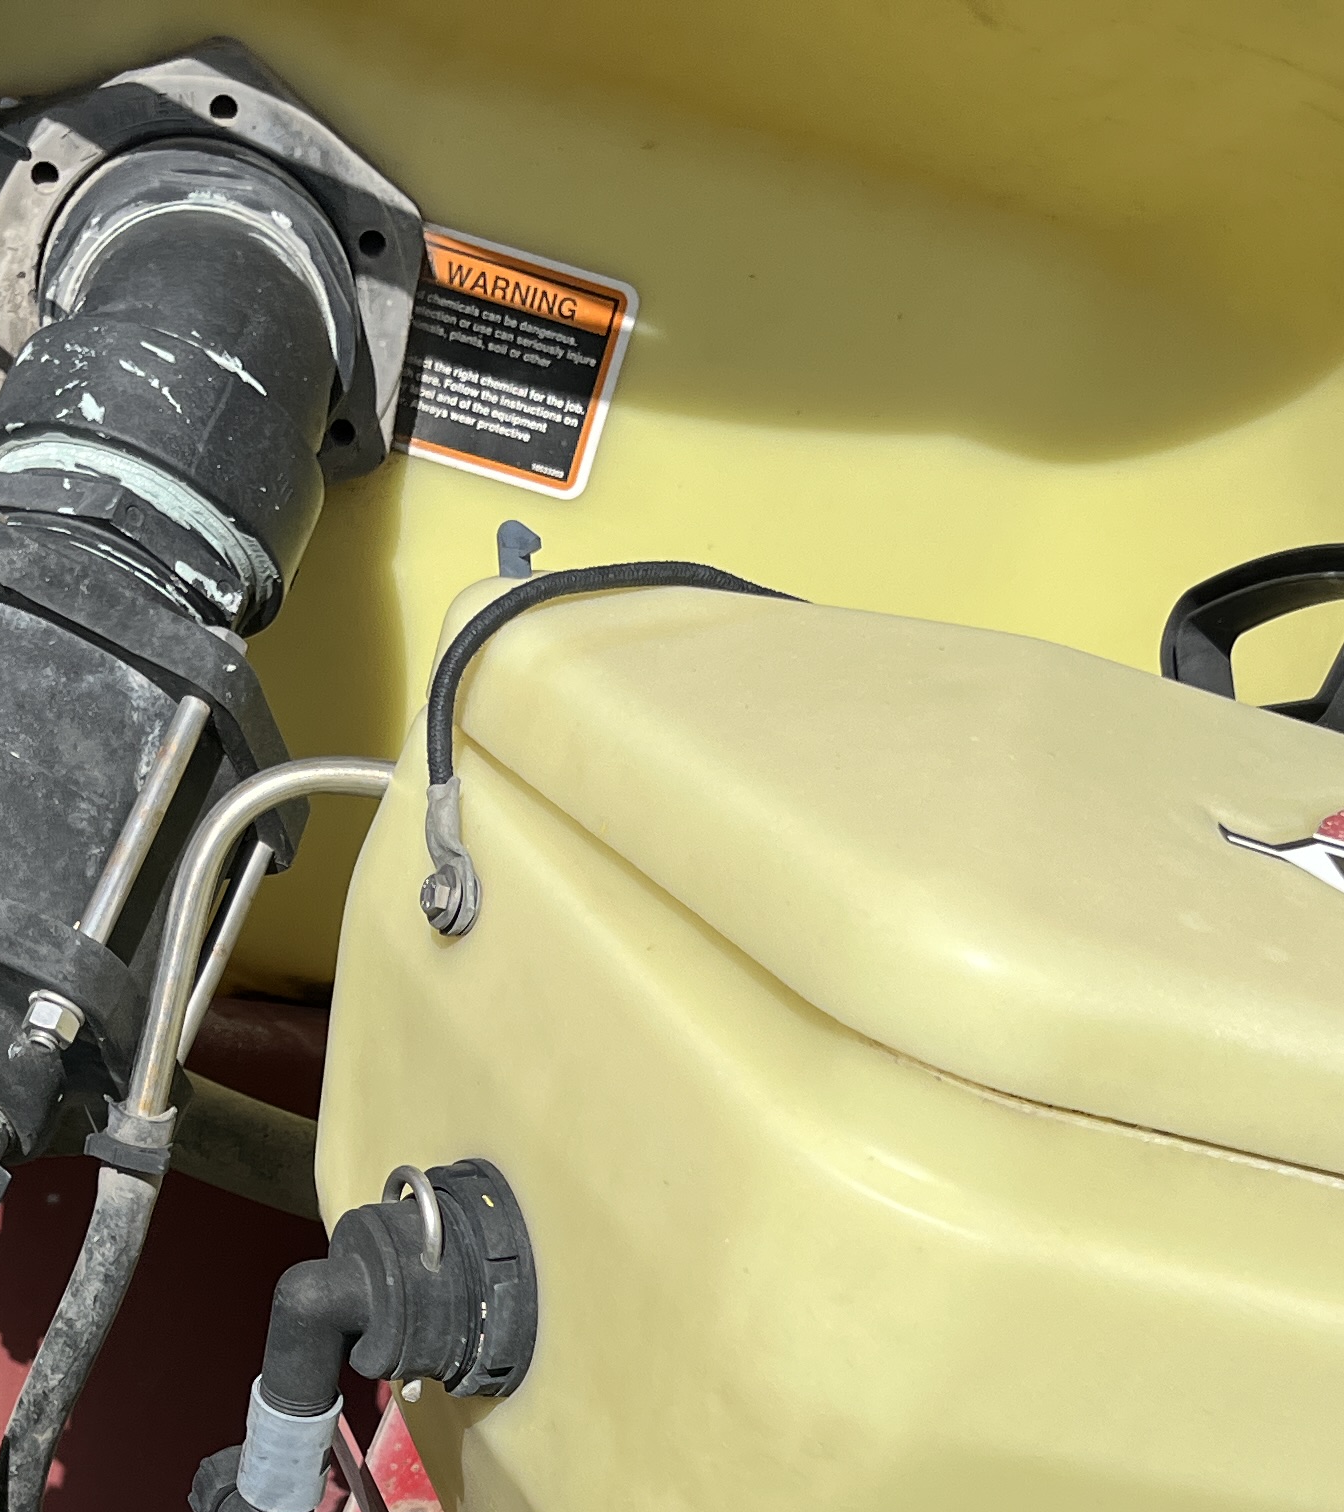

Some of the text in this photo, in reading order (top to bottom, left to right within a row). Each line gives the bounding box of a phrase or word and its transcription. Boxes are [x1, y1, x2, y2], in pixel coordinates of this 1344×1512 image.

[427, 293, 480, 317] chemicals
[482, 310, 502, 324] can
[504, 314, 518, 328] be
[448, 261, 577, 321] WARNING
[459, 319, 471, 329] or
[473, 323, 493, 336] use
[494, 329, 514, 342] can
[516, 336, 564, 359] seriously
[566, 350, 597, 367] injure
[509, 349, 522, 359] or
[523, 353, 552, 368] other
[434, 360, 452, 376] the
[452, 367, 479, 385] right
[480, 374, 528, 398] chemical
[529, 387, 546, 403] for
[546, 392, 564, 409] the
[563, 399, 585, 416] job.
[443, 378, 480, 398] Follow
[481, 389, 499, 404] the
[499, 395, 562, 423] instructions
[563, 415, 579, 428] on
[436, 392, 458, 407] and
[458, 399, 472, 411] of
[472, 401, 491, 416] the
[491, 408, 548, 434] equipment
[449, 411, 476, 427] wear
[476, 419, 531, 443] protective
